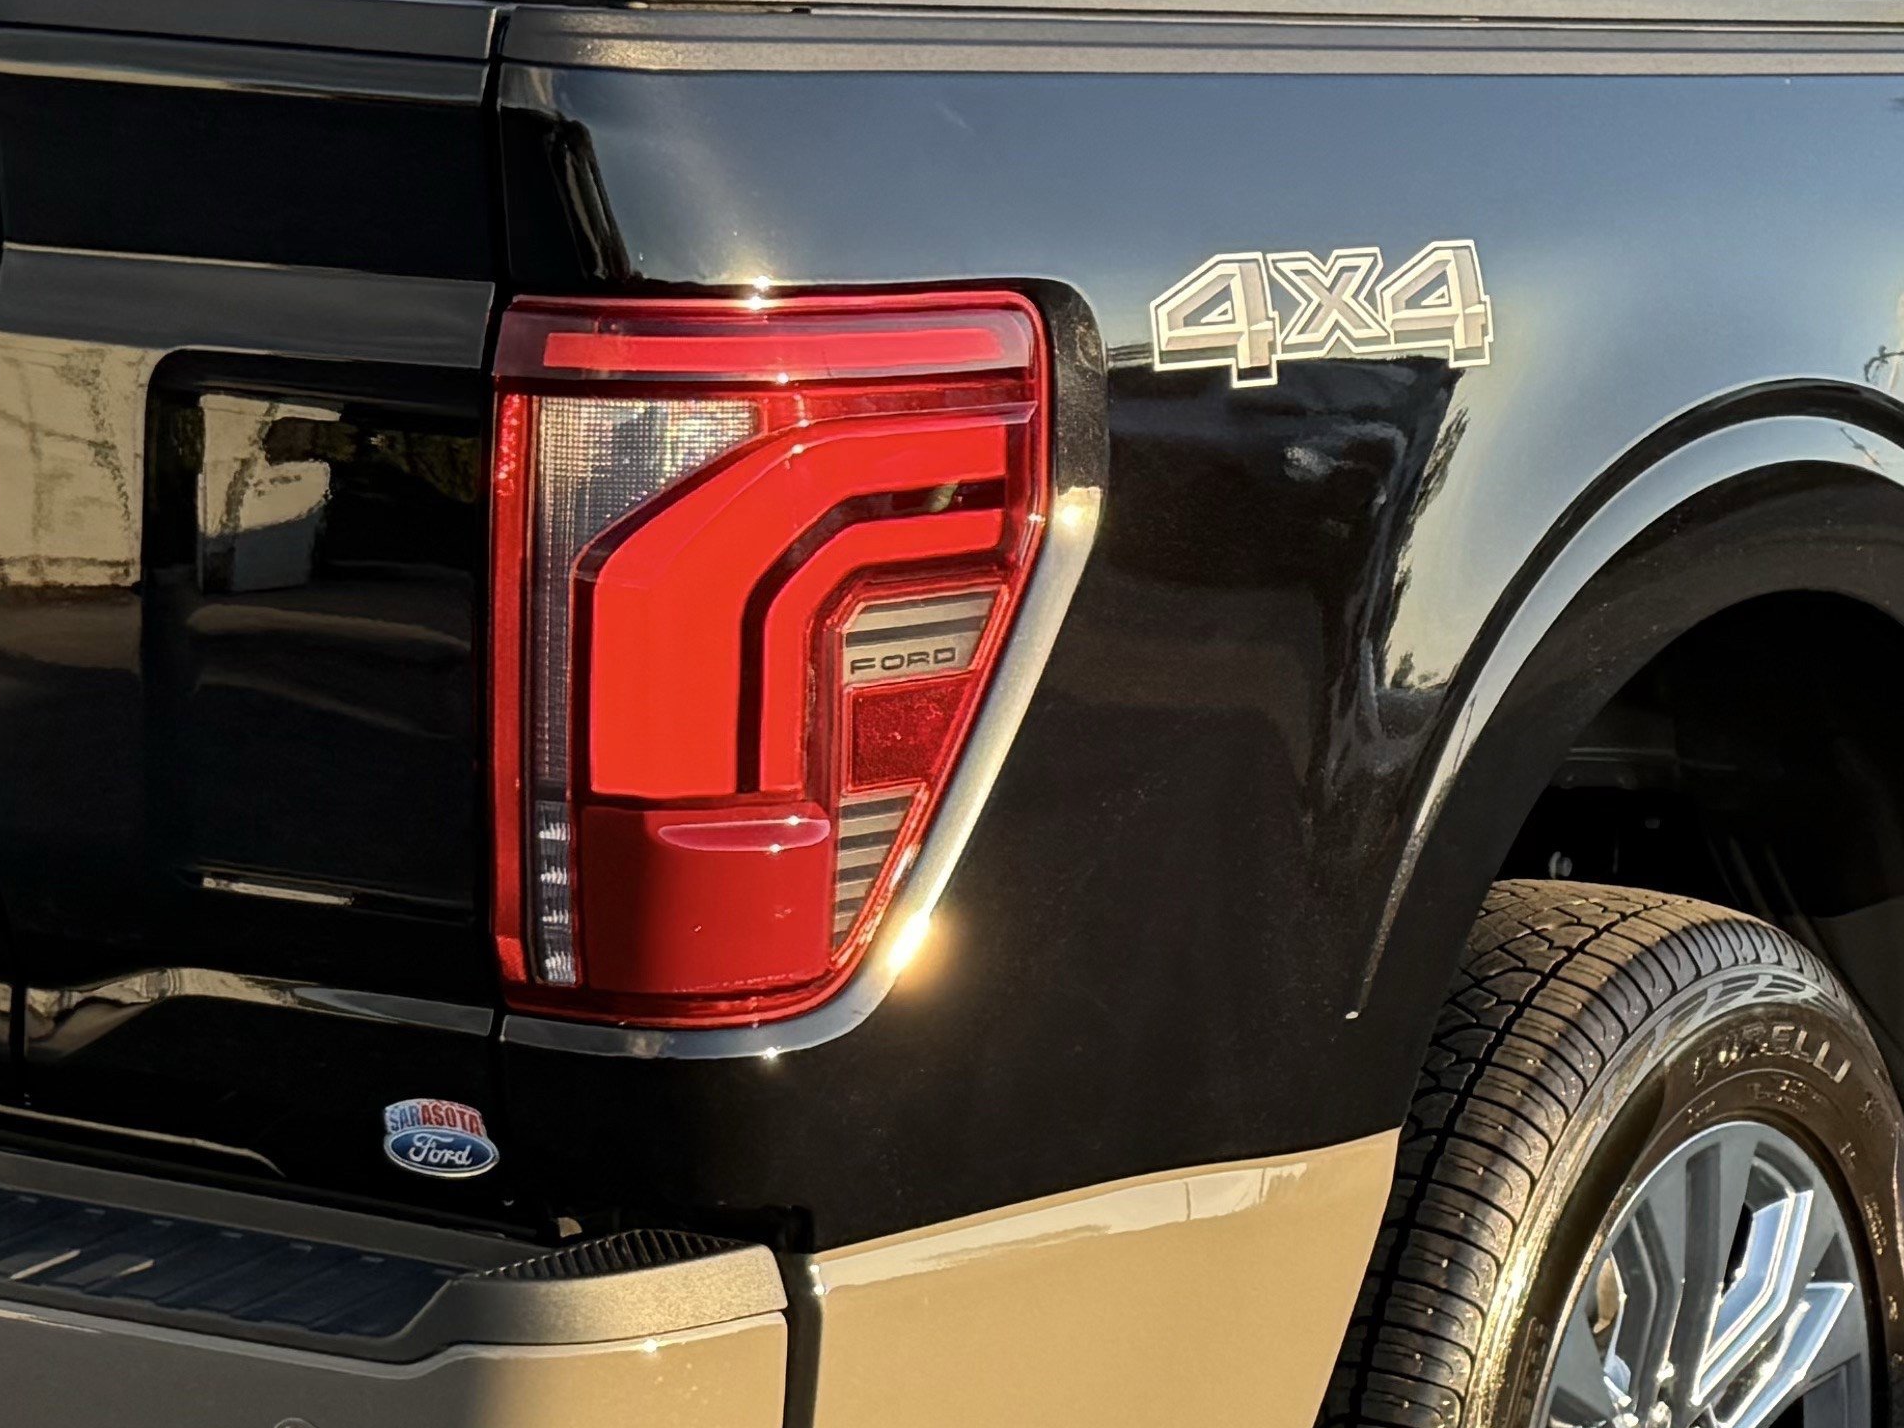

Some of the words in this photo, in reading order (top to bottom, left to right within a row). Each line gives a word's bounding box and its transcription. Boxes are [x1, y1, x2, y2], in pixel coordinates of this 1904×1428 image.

[849, 647, 957, 675] FORD
[1693, 1024, 1853, 1086] PIRELLI
[389, 1103, 484, 1138] SARASOTA
[408, 1132, 474, 1166] Ford
